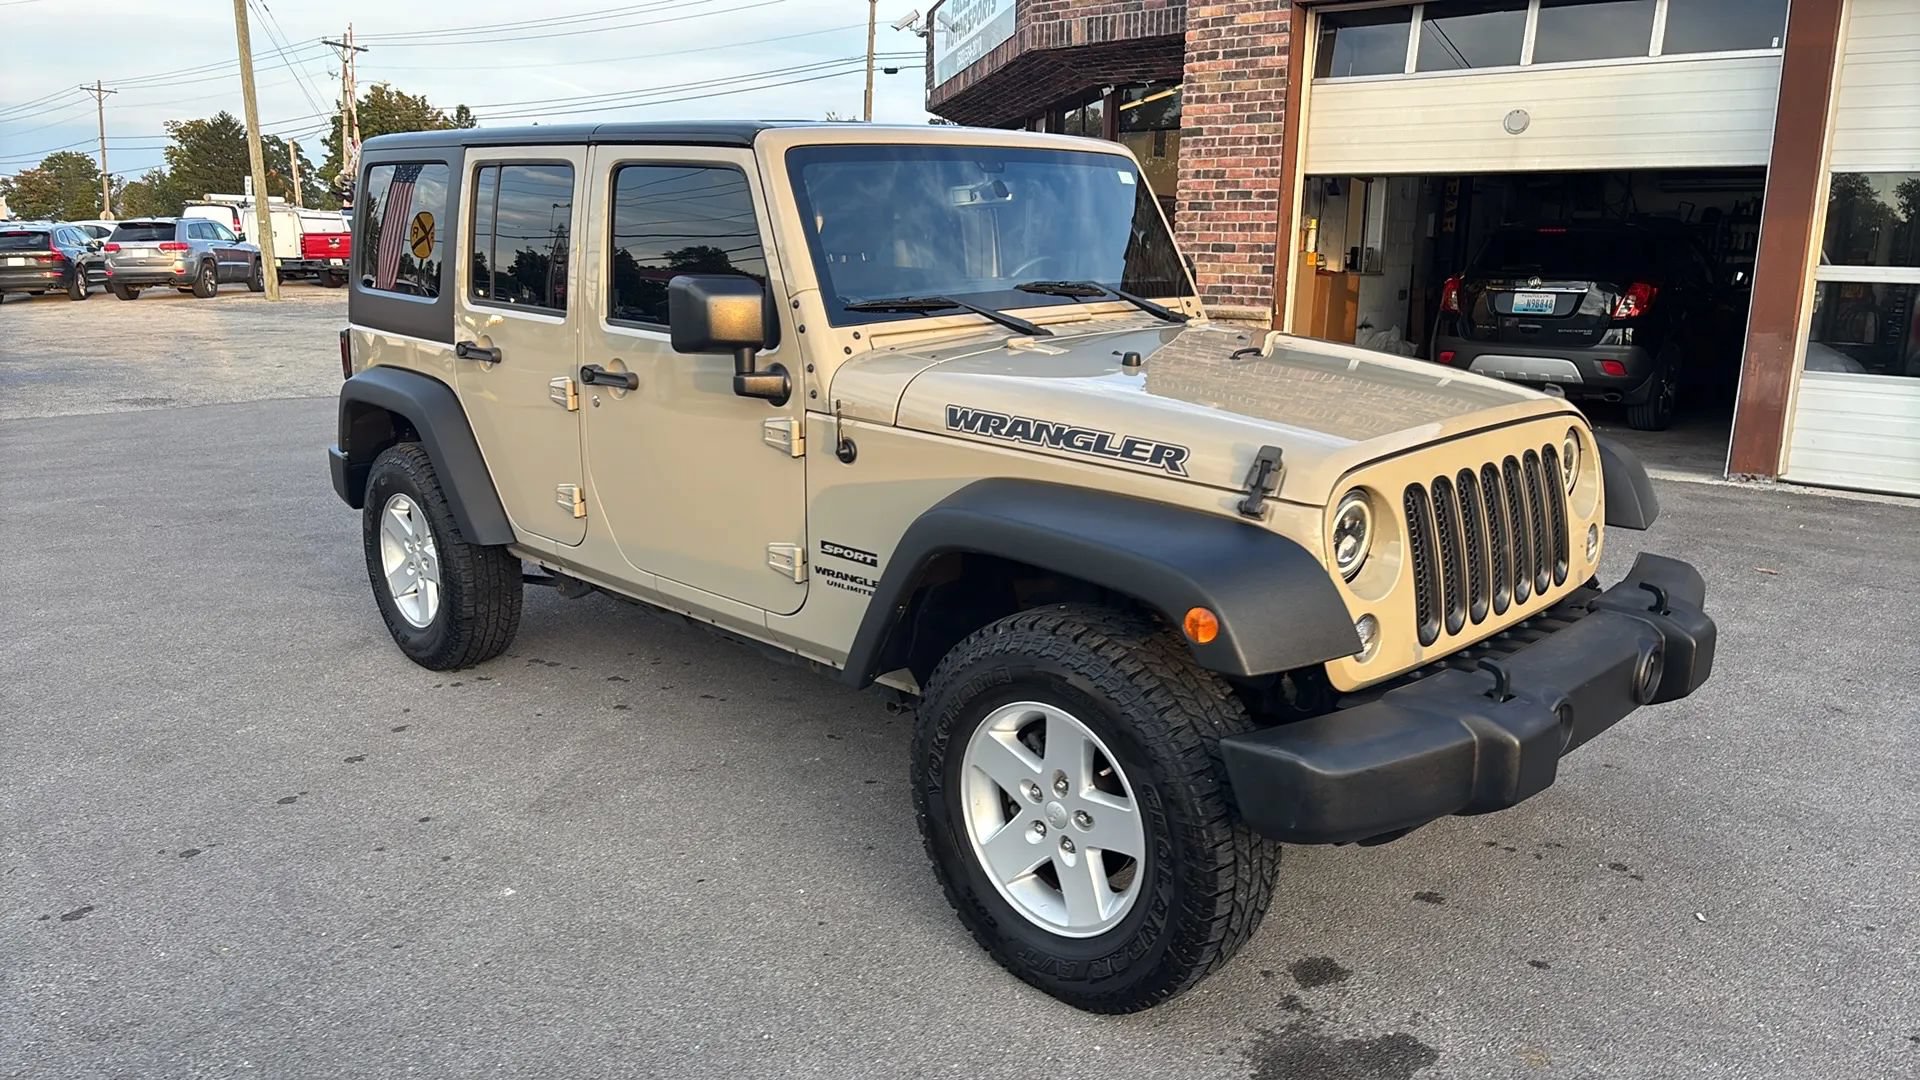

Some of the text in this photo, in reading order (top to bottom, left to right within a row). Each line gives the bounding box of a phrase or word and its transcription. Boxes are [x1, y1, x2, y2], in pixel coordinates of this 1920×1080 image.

[945, 404, 1190, 477] WRANGLER
[822, 541, 877, 566] SPORT
[927, 666, 1012, 795] YOKOHAMA
